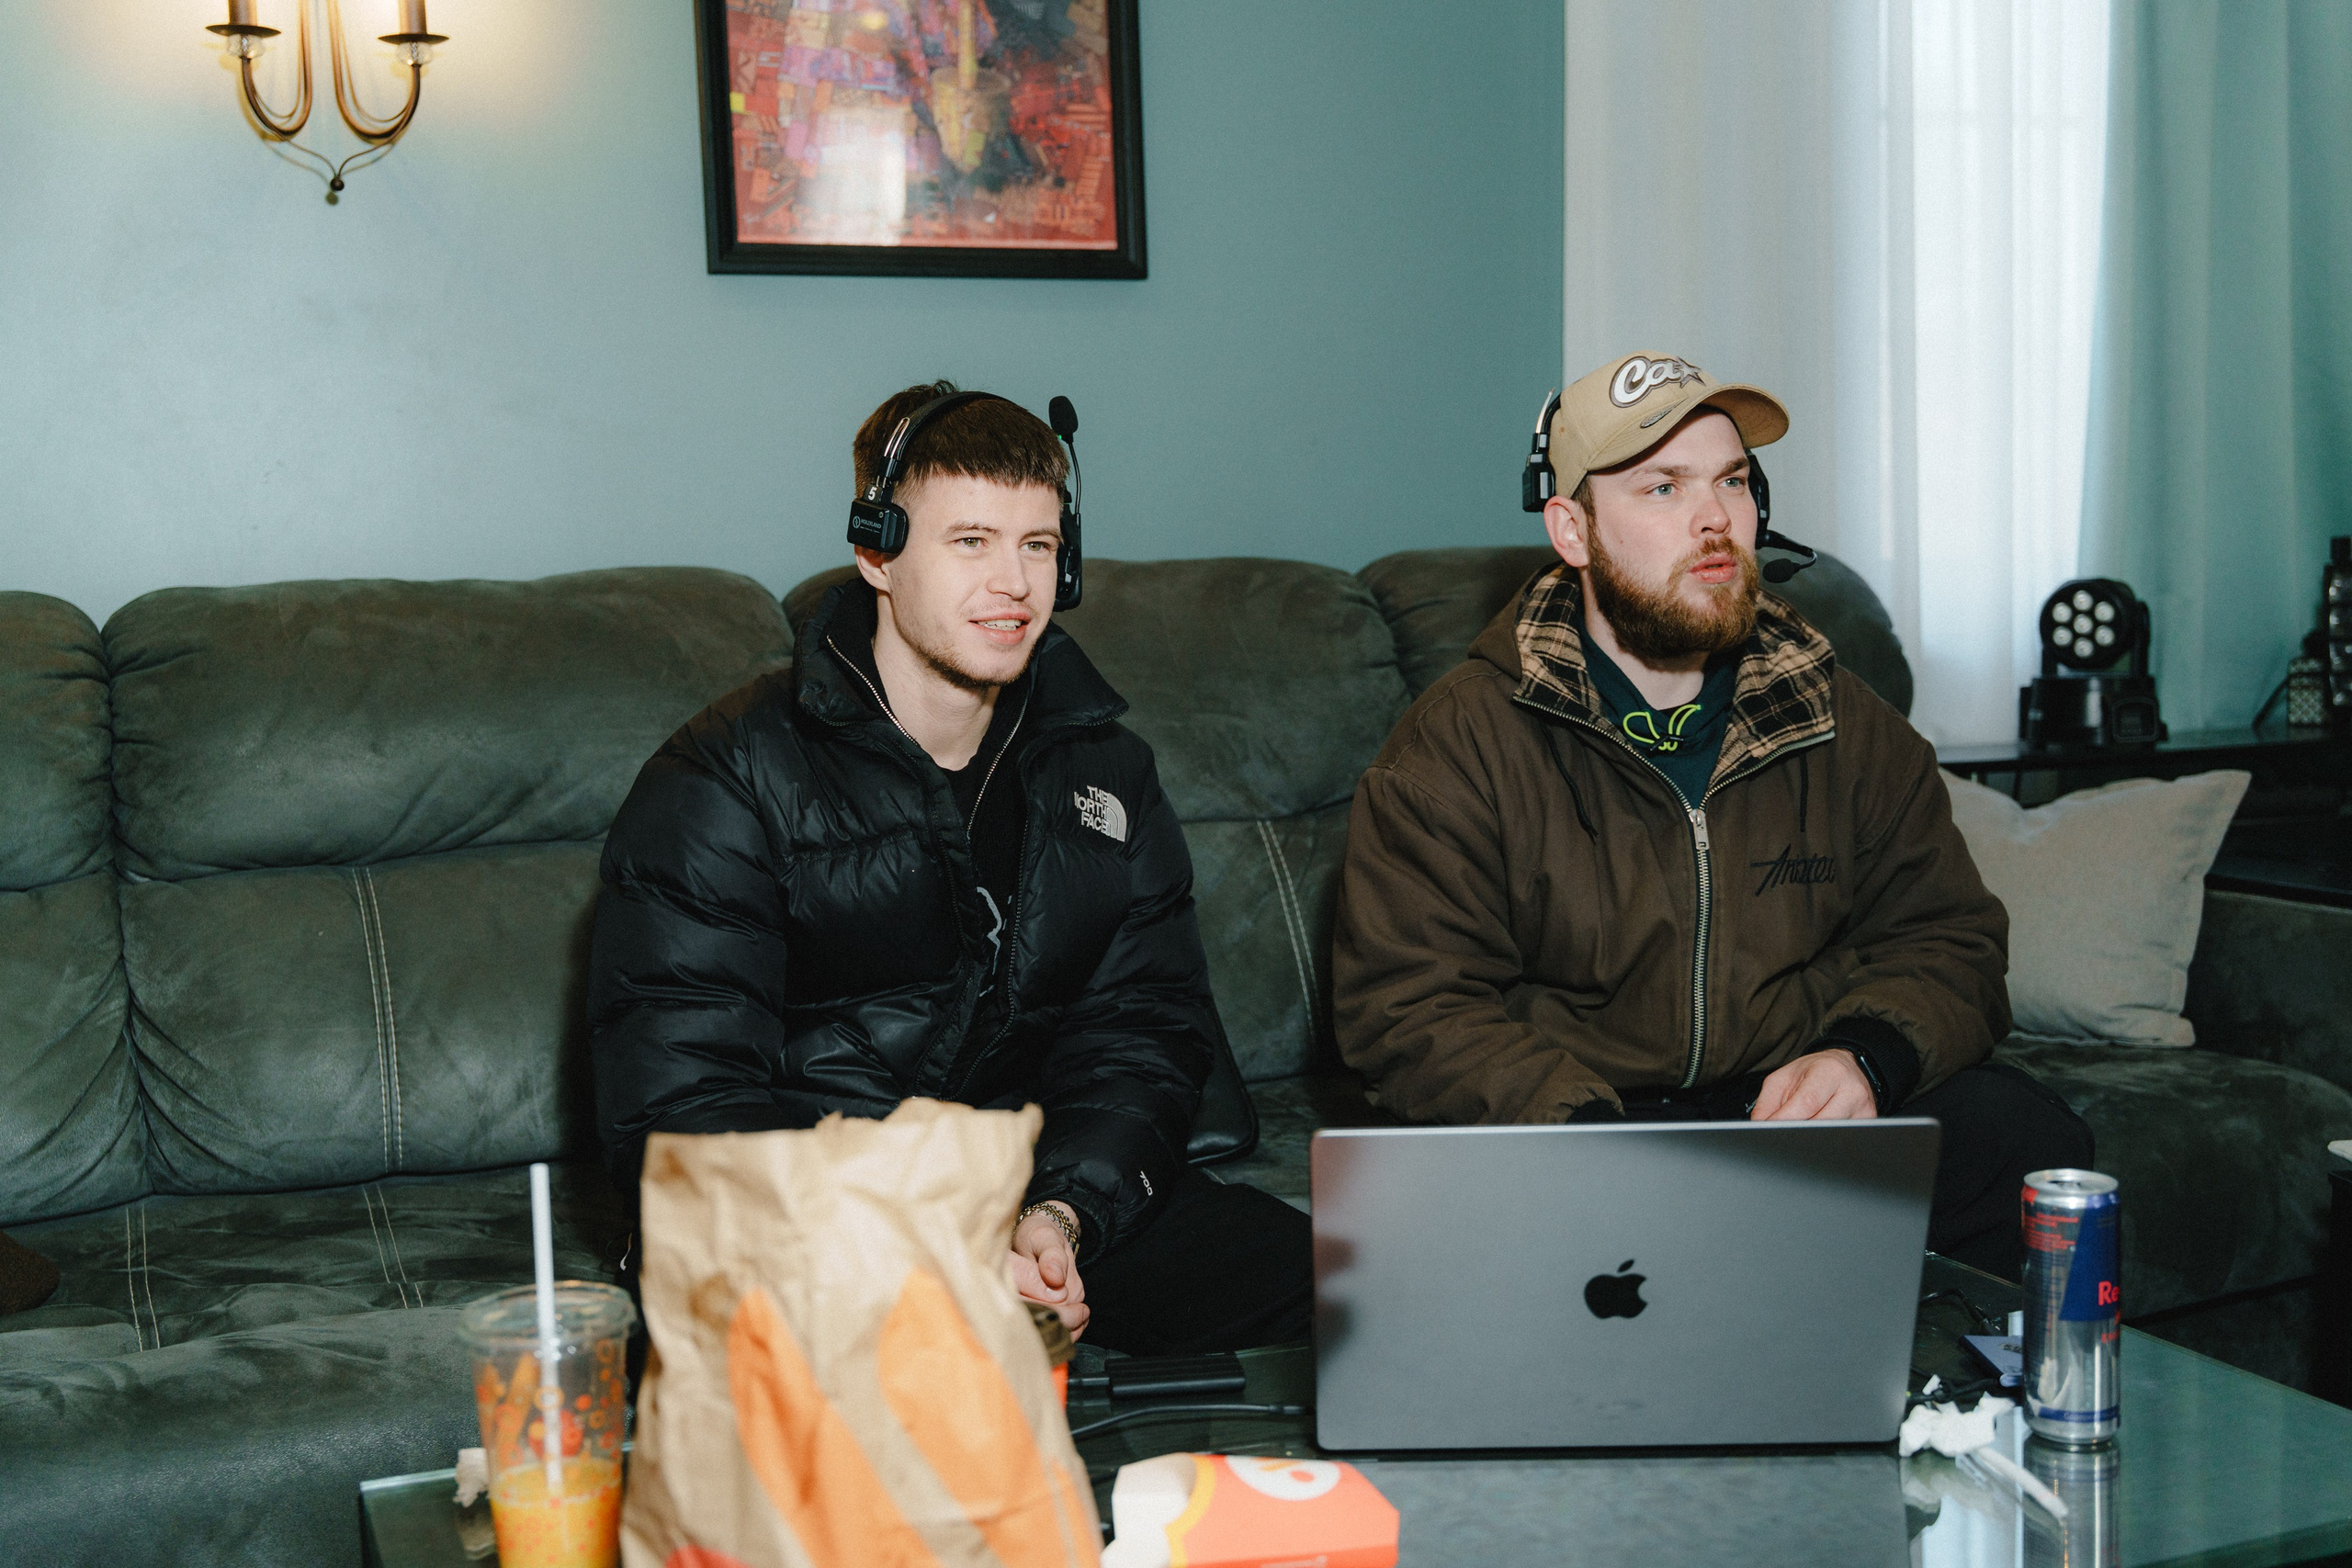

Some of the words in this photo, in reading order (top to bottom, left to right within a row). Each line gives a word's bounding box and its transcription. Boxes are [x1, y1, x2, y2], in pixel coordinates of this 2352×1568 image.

[867, 486, 877, 501] 5
[1087, 784, 1109, 807] THE
[1081, 810, 1111, 836] FACE
